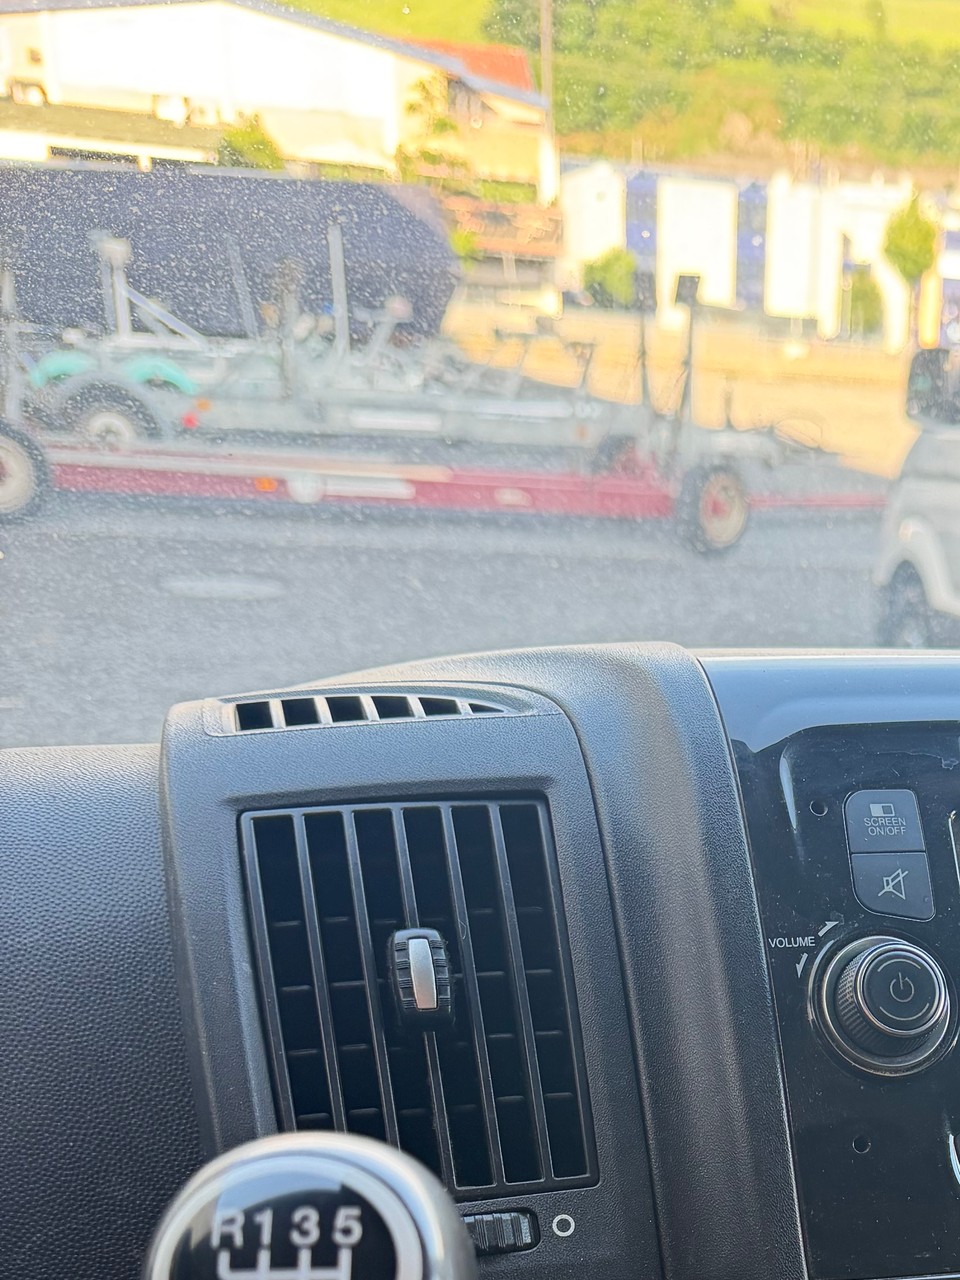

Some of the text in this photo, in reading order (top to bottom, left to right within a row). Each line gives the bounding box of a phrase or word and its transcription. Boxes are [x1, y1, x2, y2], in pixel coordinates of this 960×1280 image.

[864, 817, 906, 826] SCREEN
[868, 826, 906, 836] ON/OFF
[769, 936, 816, 948] VOLUME
